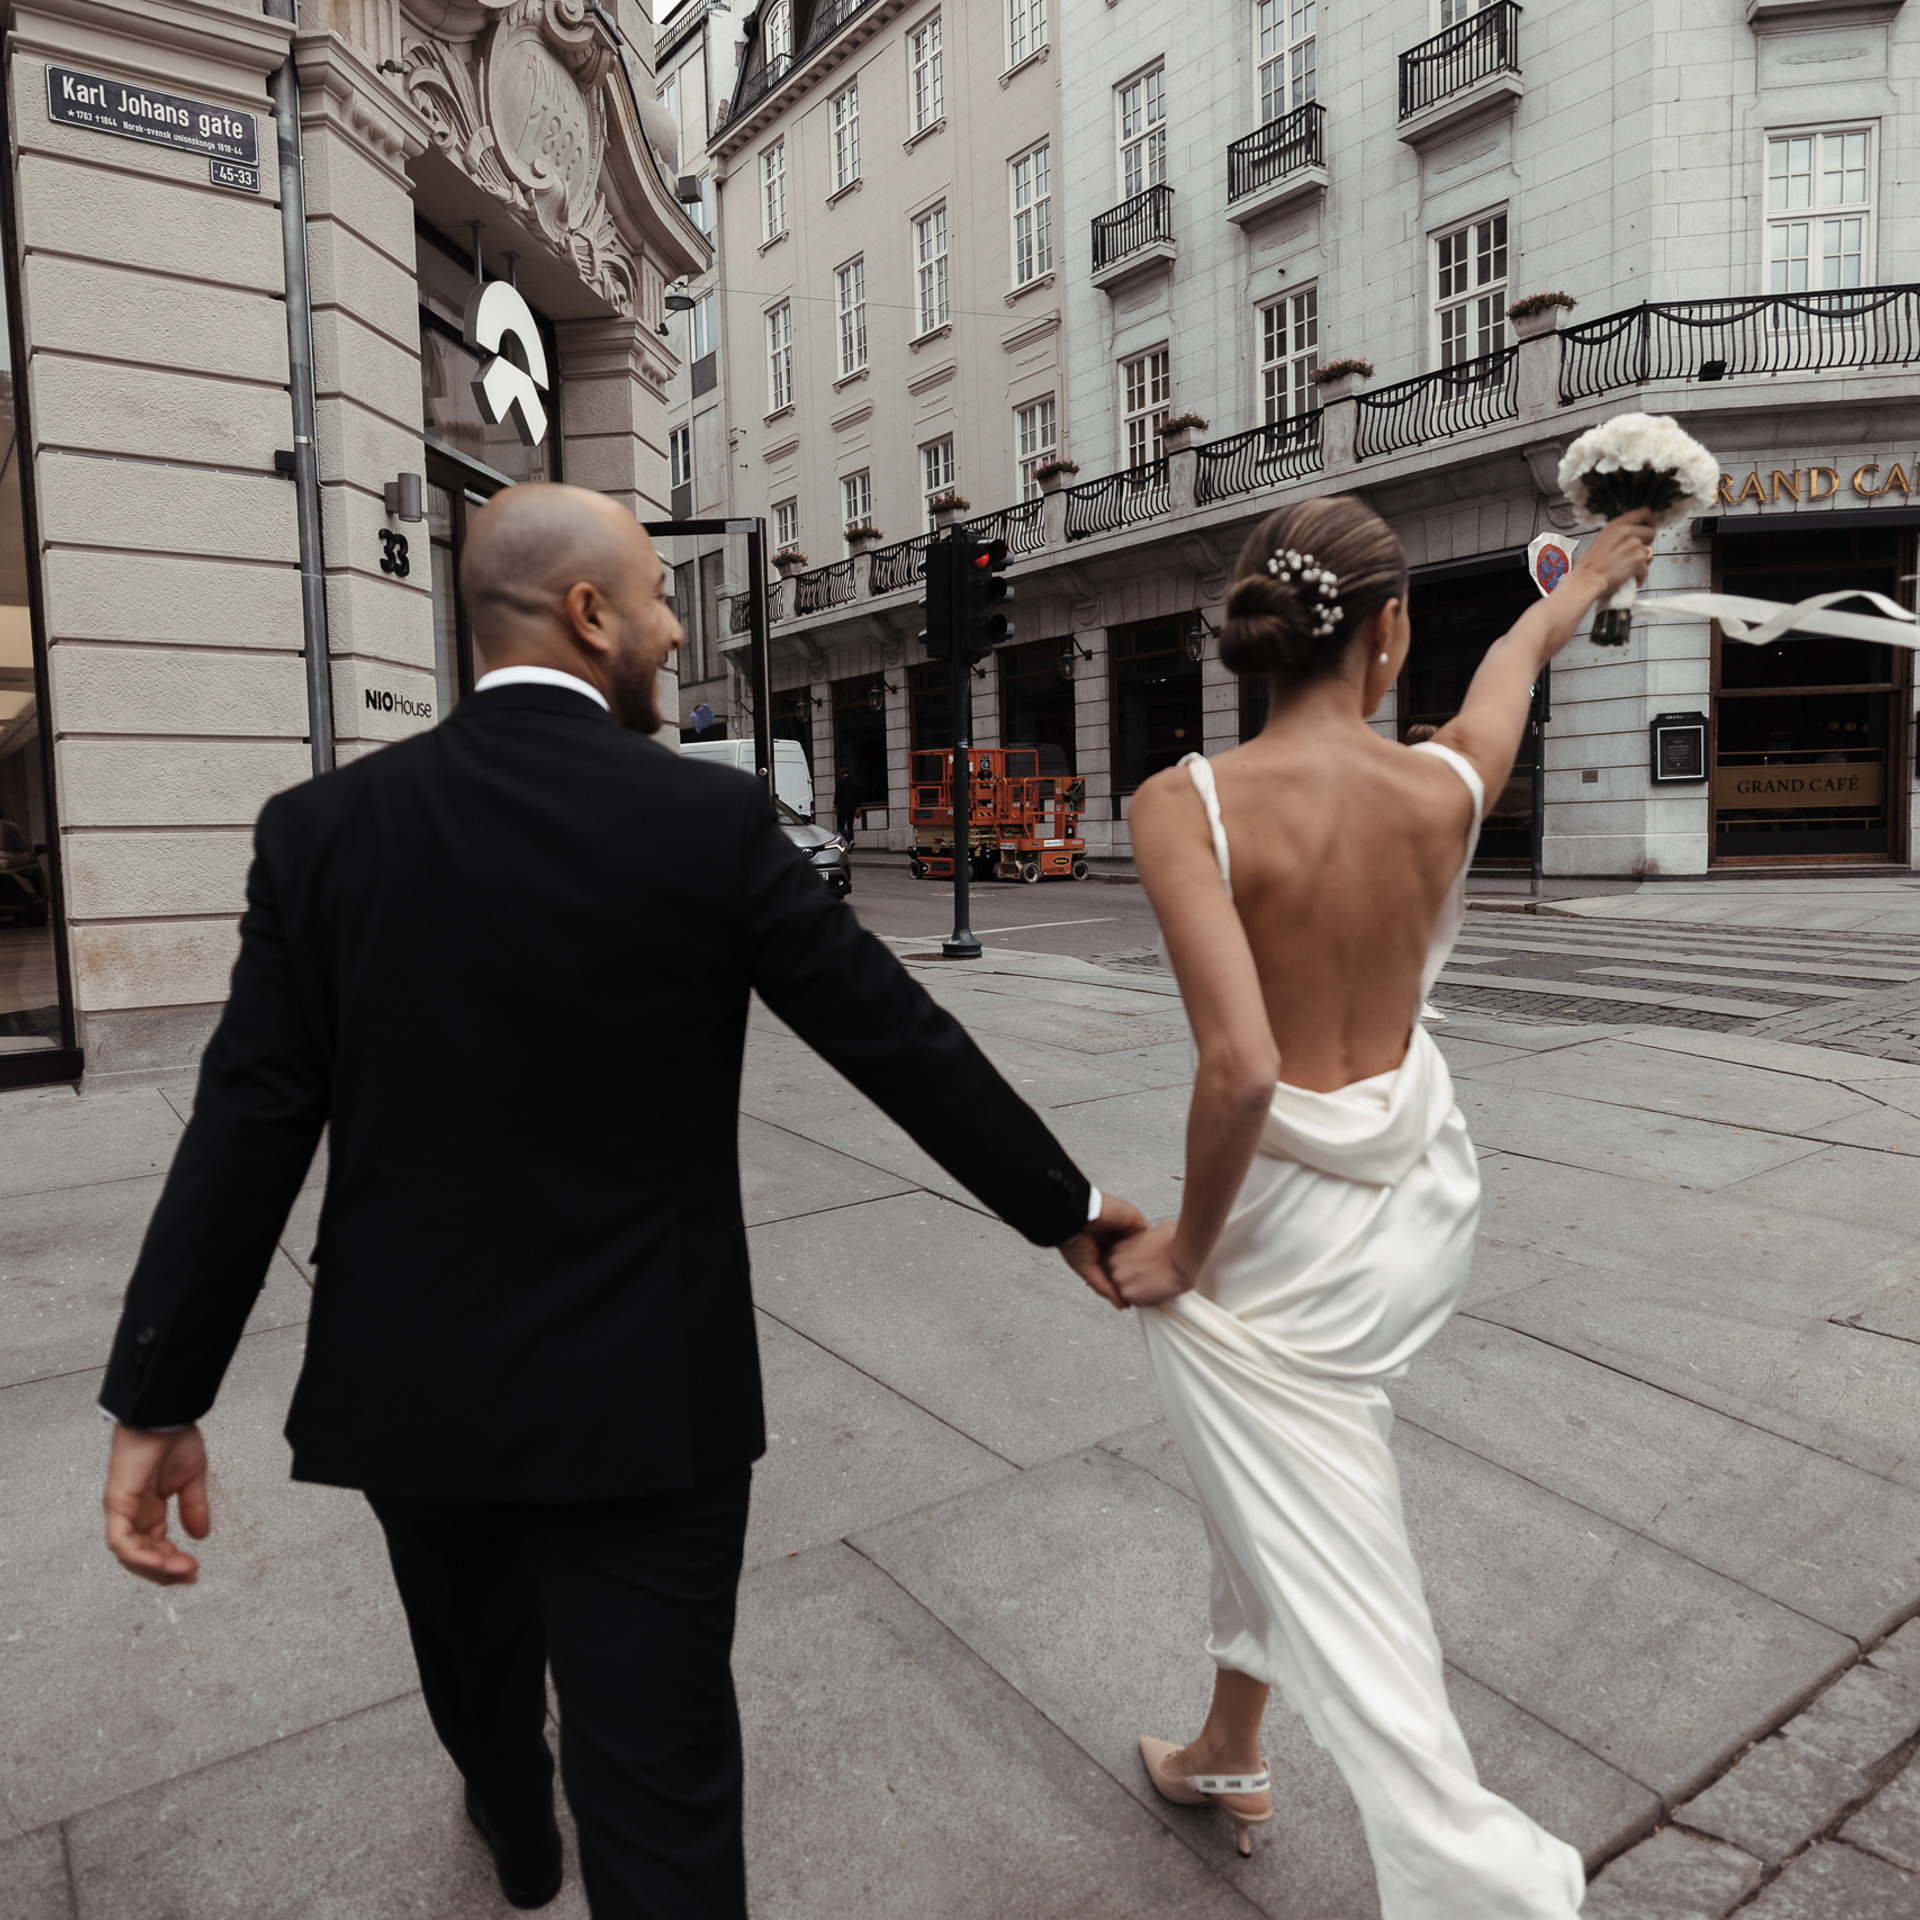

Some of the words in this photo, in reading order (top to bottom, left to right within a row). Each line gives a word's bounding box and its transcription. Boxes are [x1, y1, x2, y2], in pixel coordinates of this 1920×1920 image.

[62, 75, 107, 109] Karl
[117, 89, 190, 127] Johans
[198, 114, 243, 139] gate
[122, 120, 172, 139] Norsk-svensk
[173, 133, 215, 150] unionskonge
[220, 166, 252, 185] 45-33
[1713, 466, 1840, 504] RAND
[1853, 461, 1920, 495] CA
[378, 528, 410, 577] 33
[1737, 778, 1805, 794] GRAND
[1809, 774, 1859, 792] CAFÉ
